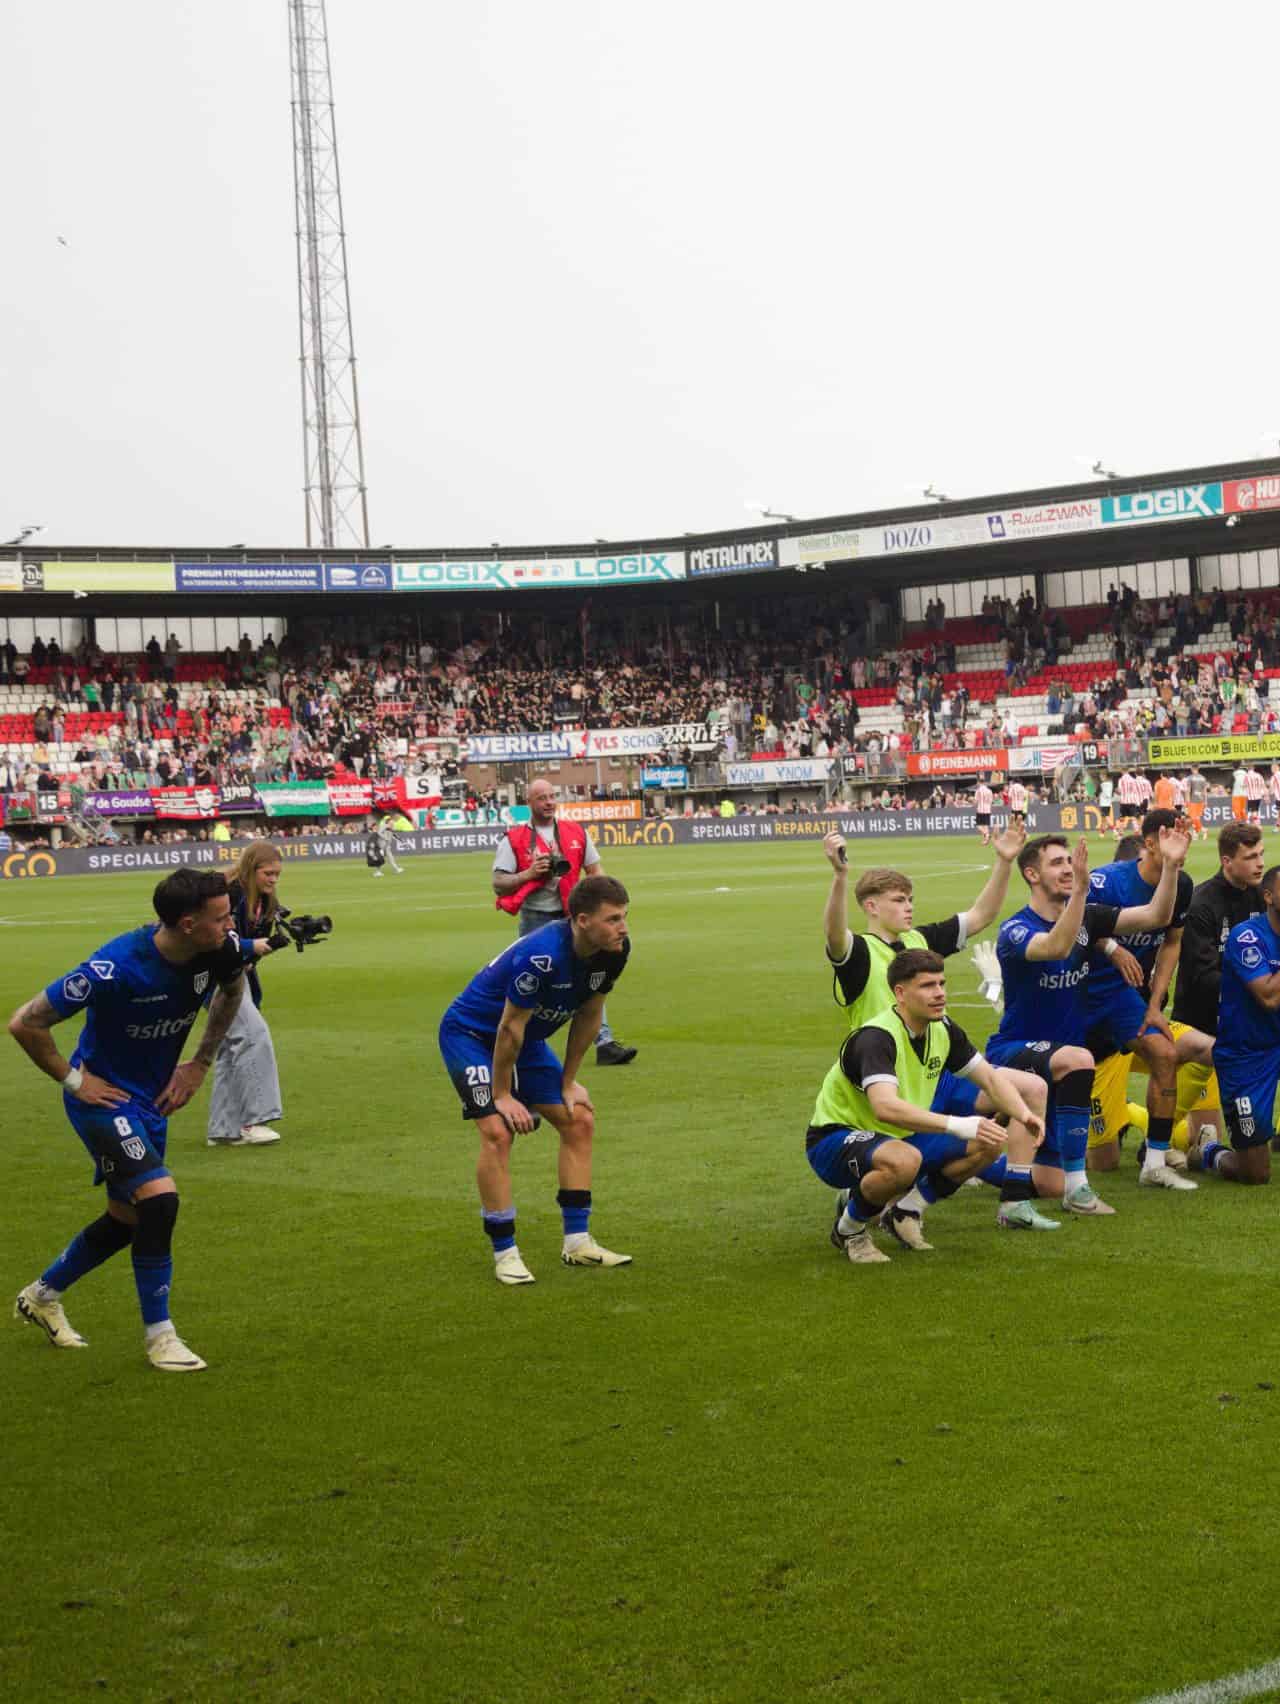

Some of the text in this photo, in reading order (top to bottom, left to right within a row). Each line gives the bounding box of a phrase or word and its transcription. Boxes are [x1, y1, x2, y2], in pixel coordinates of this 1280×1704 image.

[1112, 486, 1218, 519] LOGIX
[883, 526, 932, 551] DOZO
[689, 541, 774, 570] METALIMEX
[397, 562, 514, 588] LOGIX
[574, 555, 675, 580] LOGIX
[594, 736, 618, 751] VLS
[1084, 745, 1097, 760] 19
[1163, 743, 1219, 757] BLUE10.COM
[844, 757, 855, 771] 18
[932, 754, 997, 770] PEINEMANN
[39, 795, 57, 810] 15
[96, 795, 151, 809] de Goudse
[692, 824, 756, 839] SPECIALIST
[760, 823, 772, 834] IN
[775, 820, 838, 835] REPARATIE
[841, 820, 865, 833] VAN
[906, 817, 922, 831] EN
[89, 850, 190, 869] SPECIALIST
[197, 848, 214, 863] IN
[313, 842, 345, 857] VAN
[1039, 968, 1081, 989] asito
[127, 1014, 184, 1040] asito
[465, 1065, 491, 1085] 20
[1235, 1096, 1252, 1116] 19
[113, 1116, 133, 1137] 8
